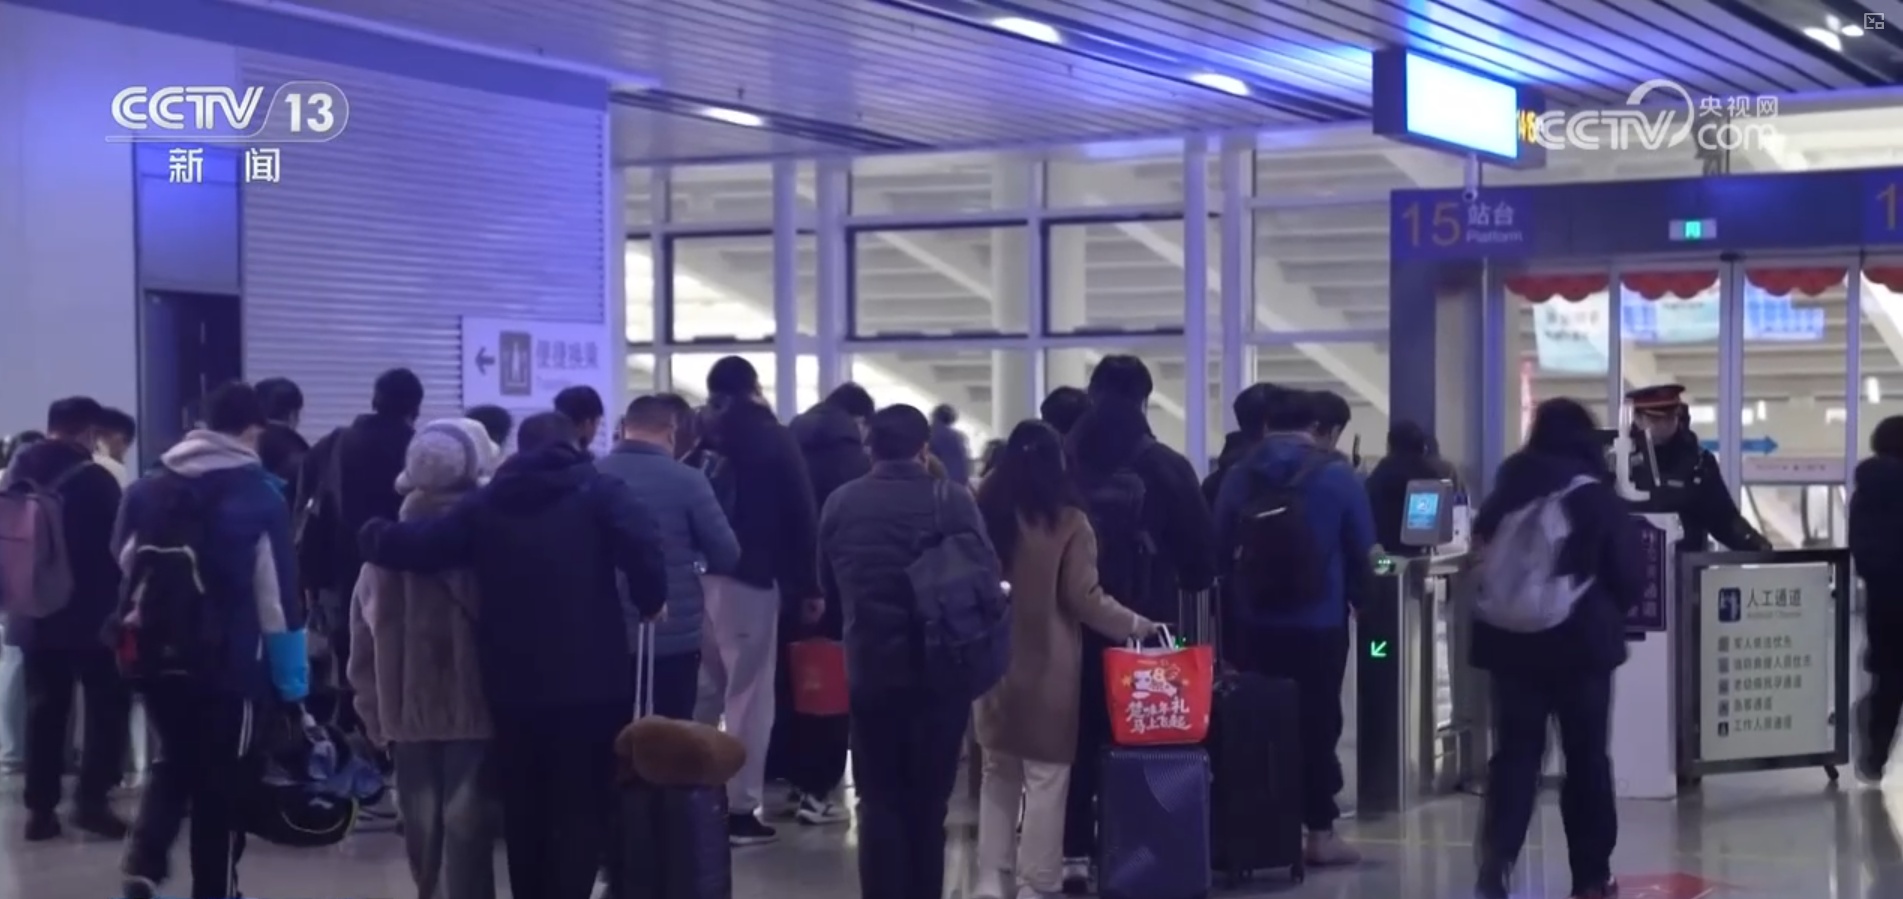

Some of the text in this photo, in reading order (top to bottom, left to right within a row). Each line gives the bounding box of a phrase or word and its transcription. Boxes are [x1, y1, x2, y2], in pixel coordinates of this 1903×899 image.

[1402, 202, 1461, 245] 15
[1468, 202, 1514, 226] 站台
[1747, 588, 1802, 608] 人工通道
